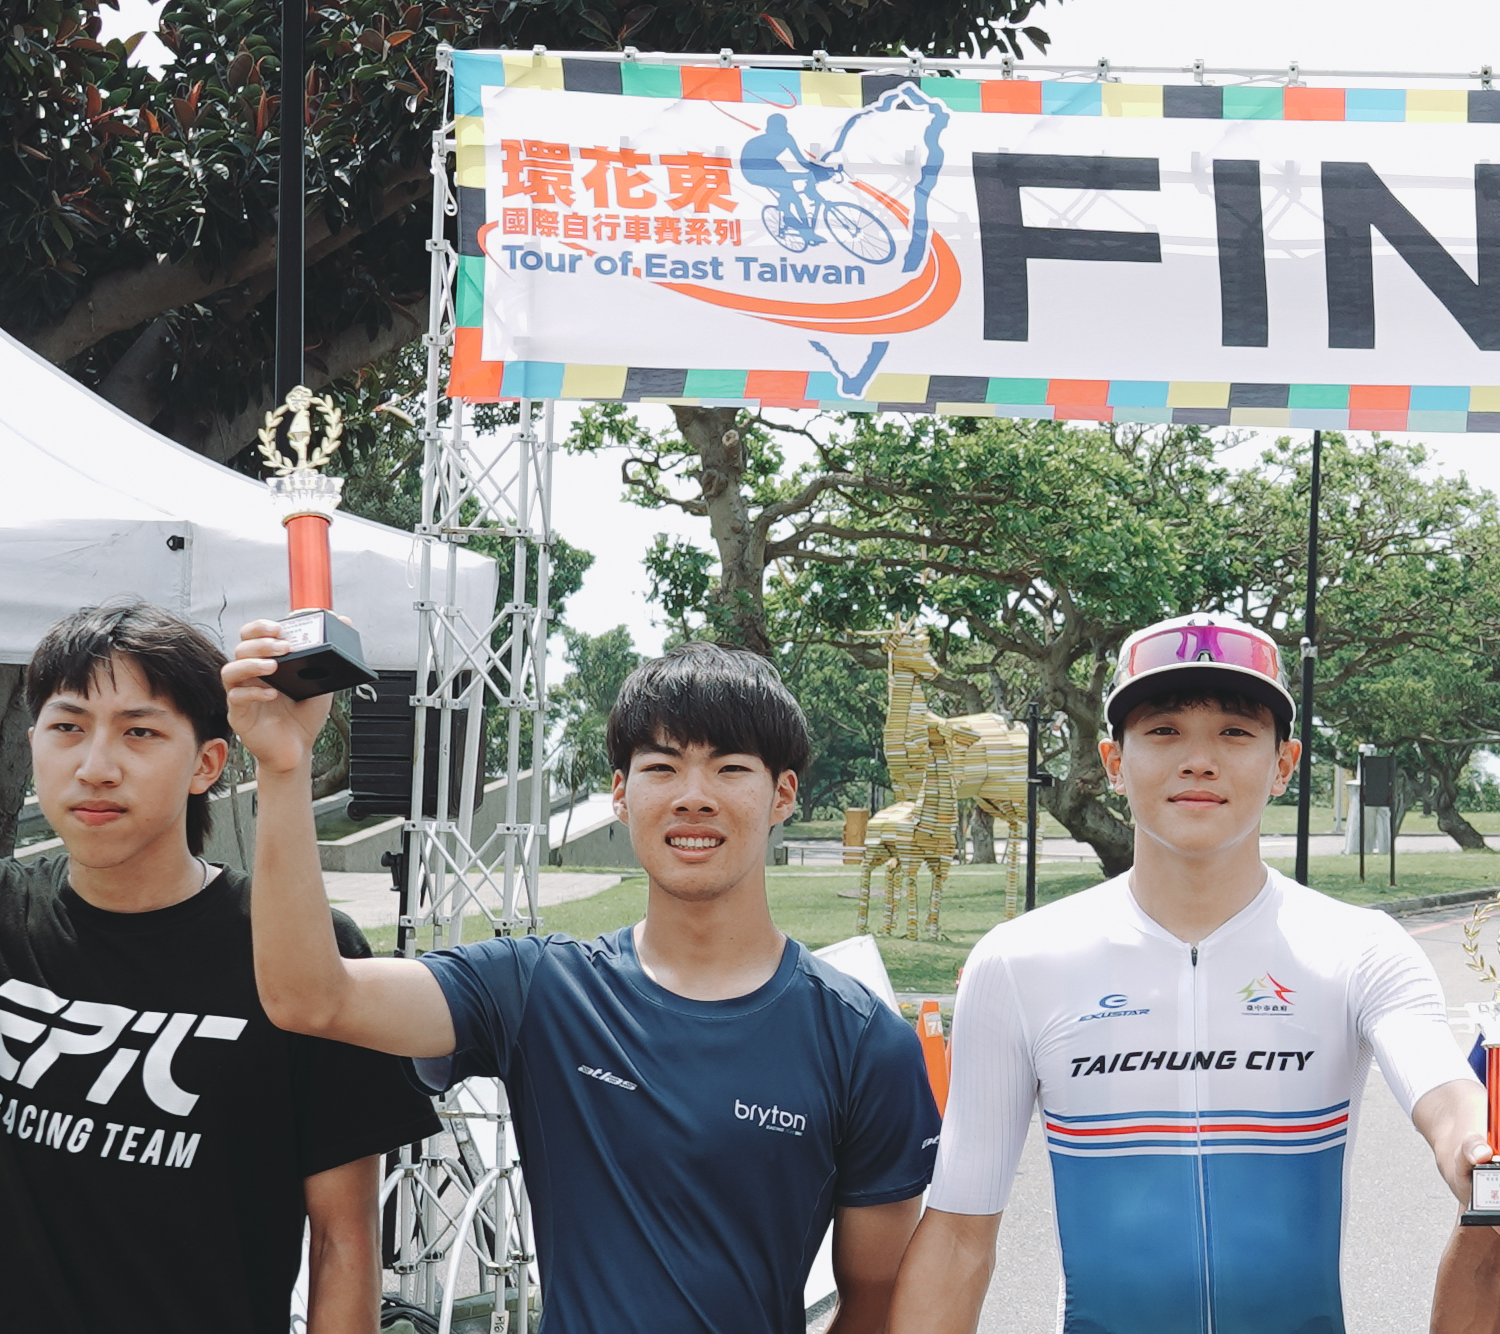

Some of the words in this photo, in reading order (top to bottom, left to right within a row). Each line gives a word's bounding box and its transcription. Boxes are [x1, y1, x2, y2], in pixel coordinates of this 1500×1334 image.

[501, 139, 739, 213] 環花東
[502, 207, 741, 246] 國際自行車賽系列
[501, 244, 583, 274] Tour
[593, 250, 634, 276] of
[645, 253, 725, 281] East
[741, 259, 866, 286] Taiwan
[1071, 1050, 1237, 1078] TAICHUNG
[1245, 1050, 1316, 1072] CITY
[734, 1097, 807, 1131] bryton
[100, 1123, 202, 1169] TEAM
